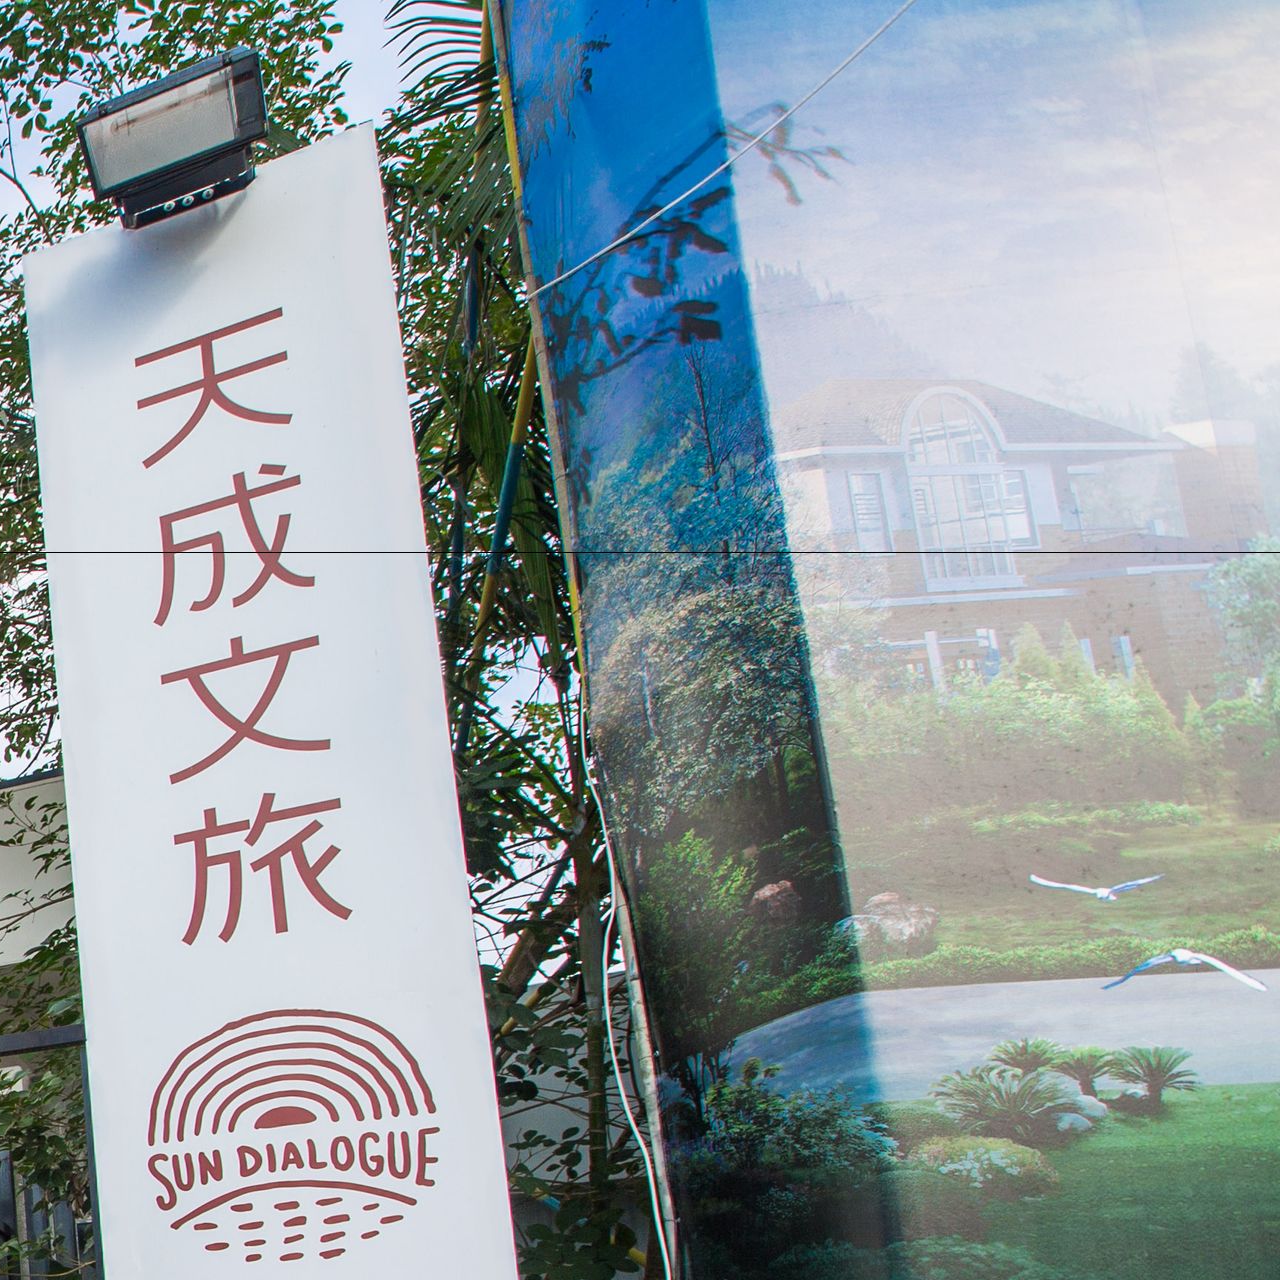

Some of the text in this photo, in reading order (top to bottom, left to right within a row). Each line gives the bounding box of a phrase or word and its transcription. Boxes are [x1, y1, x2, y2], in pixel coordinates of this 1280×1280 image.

[134, 307, 353, 945] 天成文旅
[148, 1127, 440, 1211] SUN DIALOGUE
